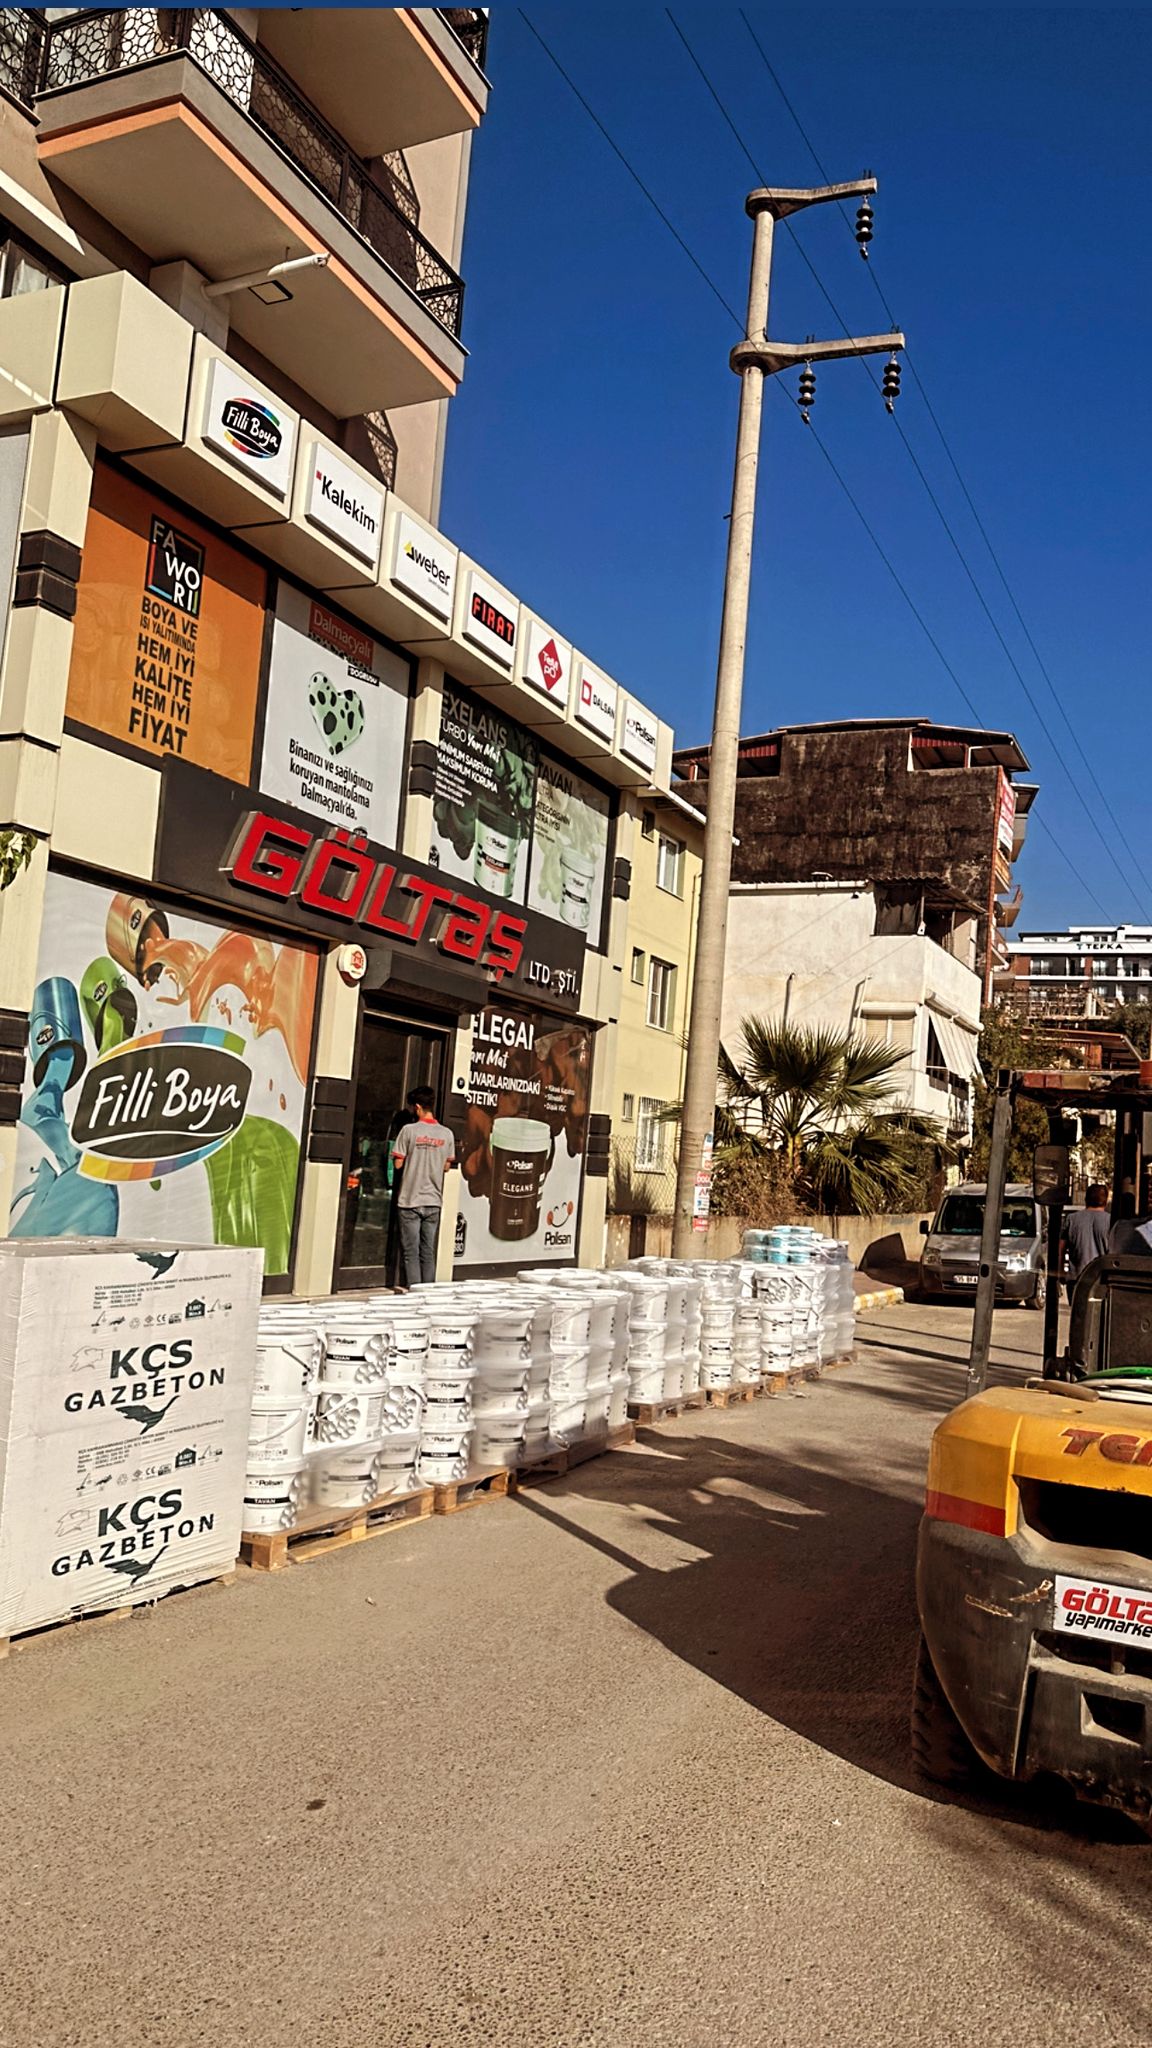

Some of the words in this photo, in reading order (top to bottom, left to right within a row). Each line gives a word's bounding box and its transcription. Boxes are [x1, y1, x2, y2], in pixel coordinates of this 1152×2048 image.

[226, 407, 250, 430] Filli
[250, 417, 279, 448] Boya
[321, 476, 375, 533] Kalekim
[414, 549, 451, 587] weber
[142, 595, 176, 630] BOYA
[182, 617, 199, 641] VE
[152, 619, 196, 654] YALITIMINDA
[313, 609, 371, 659] Dalmaçyalı
[473, 597, 514, 642] FIRAT
[138, 632, 171, 665] HEM
[175, 649, 196, 677] İYİ
[135, 656, 193, 703] KALİTE
[132, 682, 167, 714] HEM
[170, 695, 191, 725] İYİ
[593, 694, 615, 720] DALSAN
[129, 706, 188, 755] FİYAT
[289, 738, 324, 768] Binanızı
[325, 759, 334, 774] ve
[335, 764, 374, 792] sağlığınızı
[290, 757, 324, 787] koruyan
[325, 778, 370, 809] mantolama
[530, 960, 555, 986] LTD.
[486, 1048, 510, 1069] Mat
[88, 1066, 158, 1129] Filli
[161, 1066, 241, 1131] Boya
[465, 1089, 498, 1107] STETİK!
[469, 1071, 541, 1095] UVARLARINIZDAKİ
[503, 1182, 534, 1193] ELEGANS
[544, 1231, 572, 1246] Polisan
[109, 1339, 193, 1380] KÇS
[64, 1367, 225, 1413] GAZBETON
[97, 1488, 183, 1538] KÇS
[51, 1513, 214, 1577] GAZBETON
